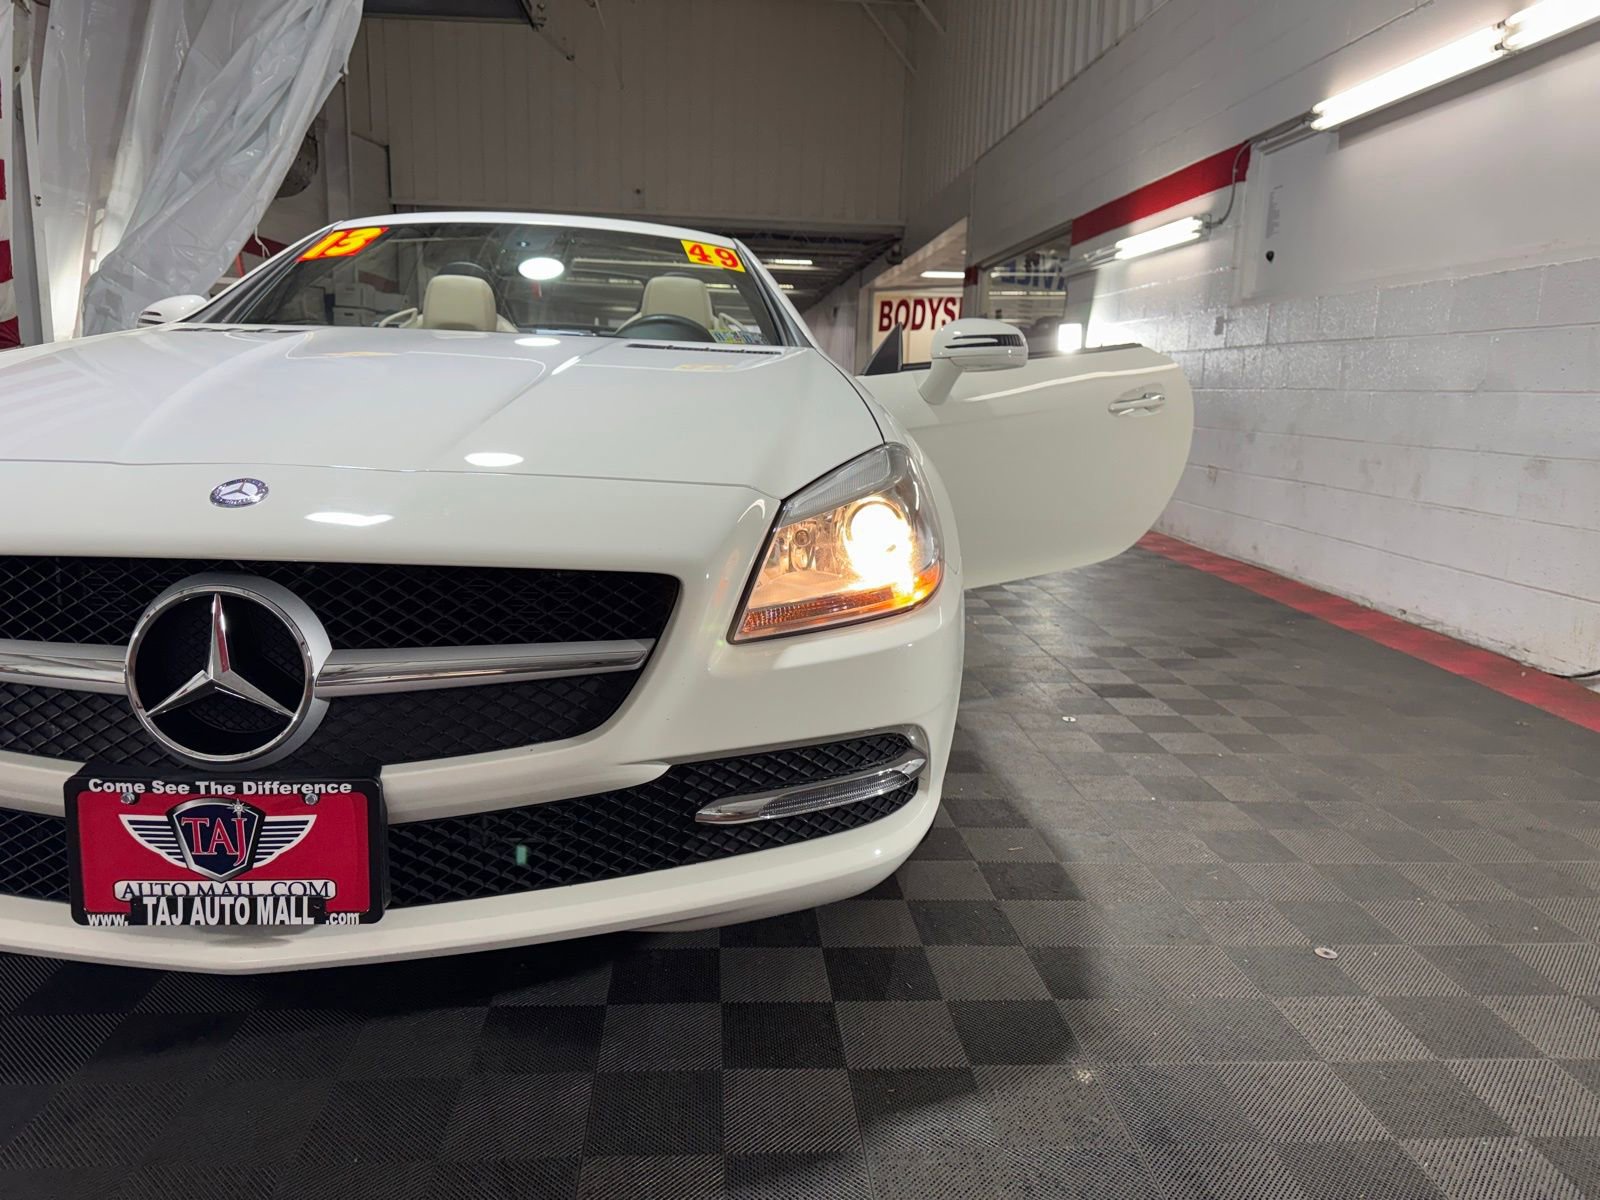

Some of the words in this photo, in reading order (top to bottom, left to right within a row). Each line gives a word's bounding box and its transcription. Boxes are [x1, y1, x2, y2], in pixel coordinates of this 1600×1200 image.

[302, 227, 382, 259] 13
[689, 243, 738, 268] 49
[88, 778, 146, 793] Come
[151, 780, 190, 794] See
[195, 781, 236, 795] The
[242, 781, 352, 795] Difference
[181, 817, 247, 866] TAJ
[121, 882, 190, 899] AUTO
[87, 914, 129, 926] www.
[142, 896, 184, 926] TAJ
[190, 896, 250, 926] AUTO
[256, 896, 315, 925] MALL
[325, 912, 360, 925] .com
